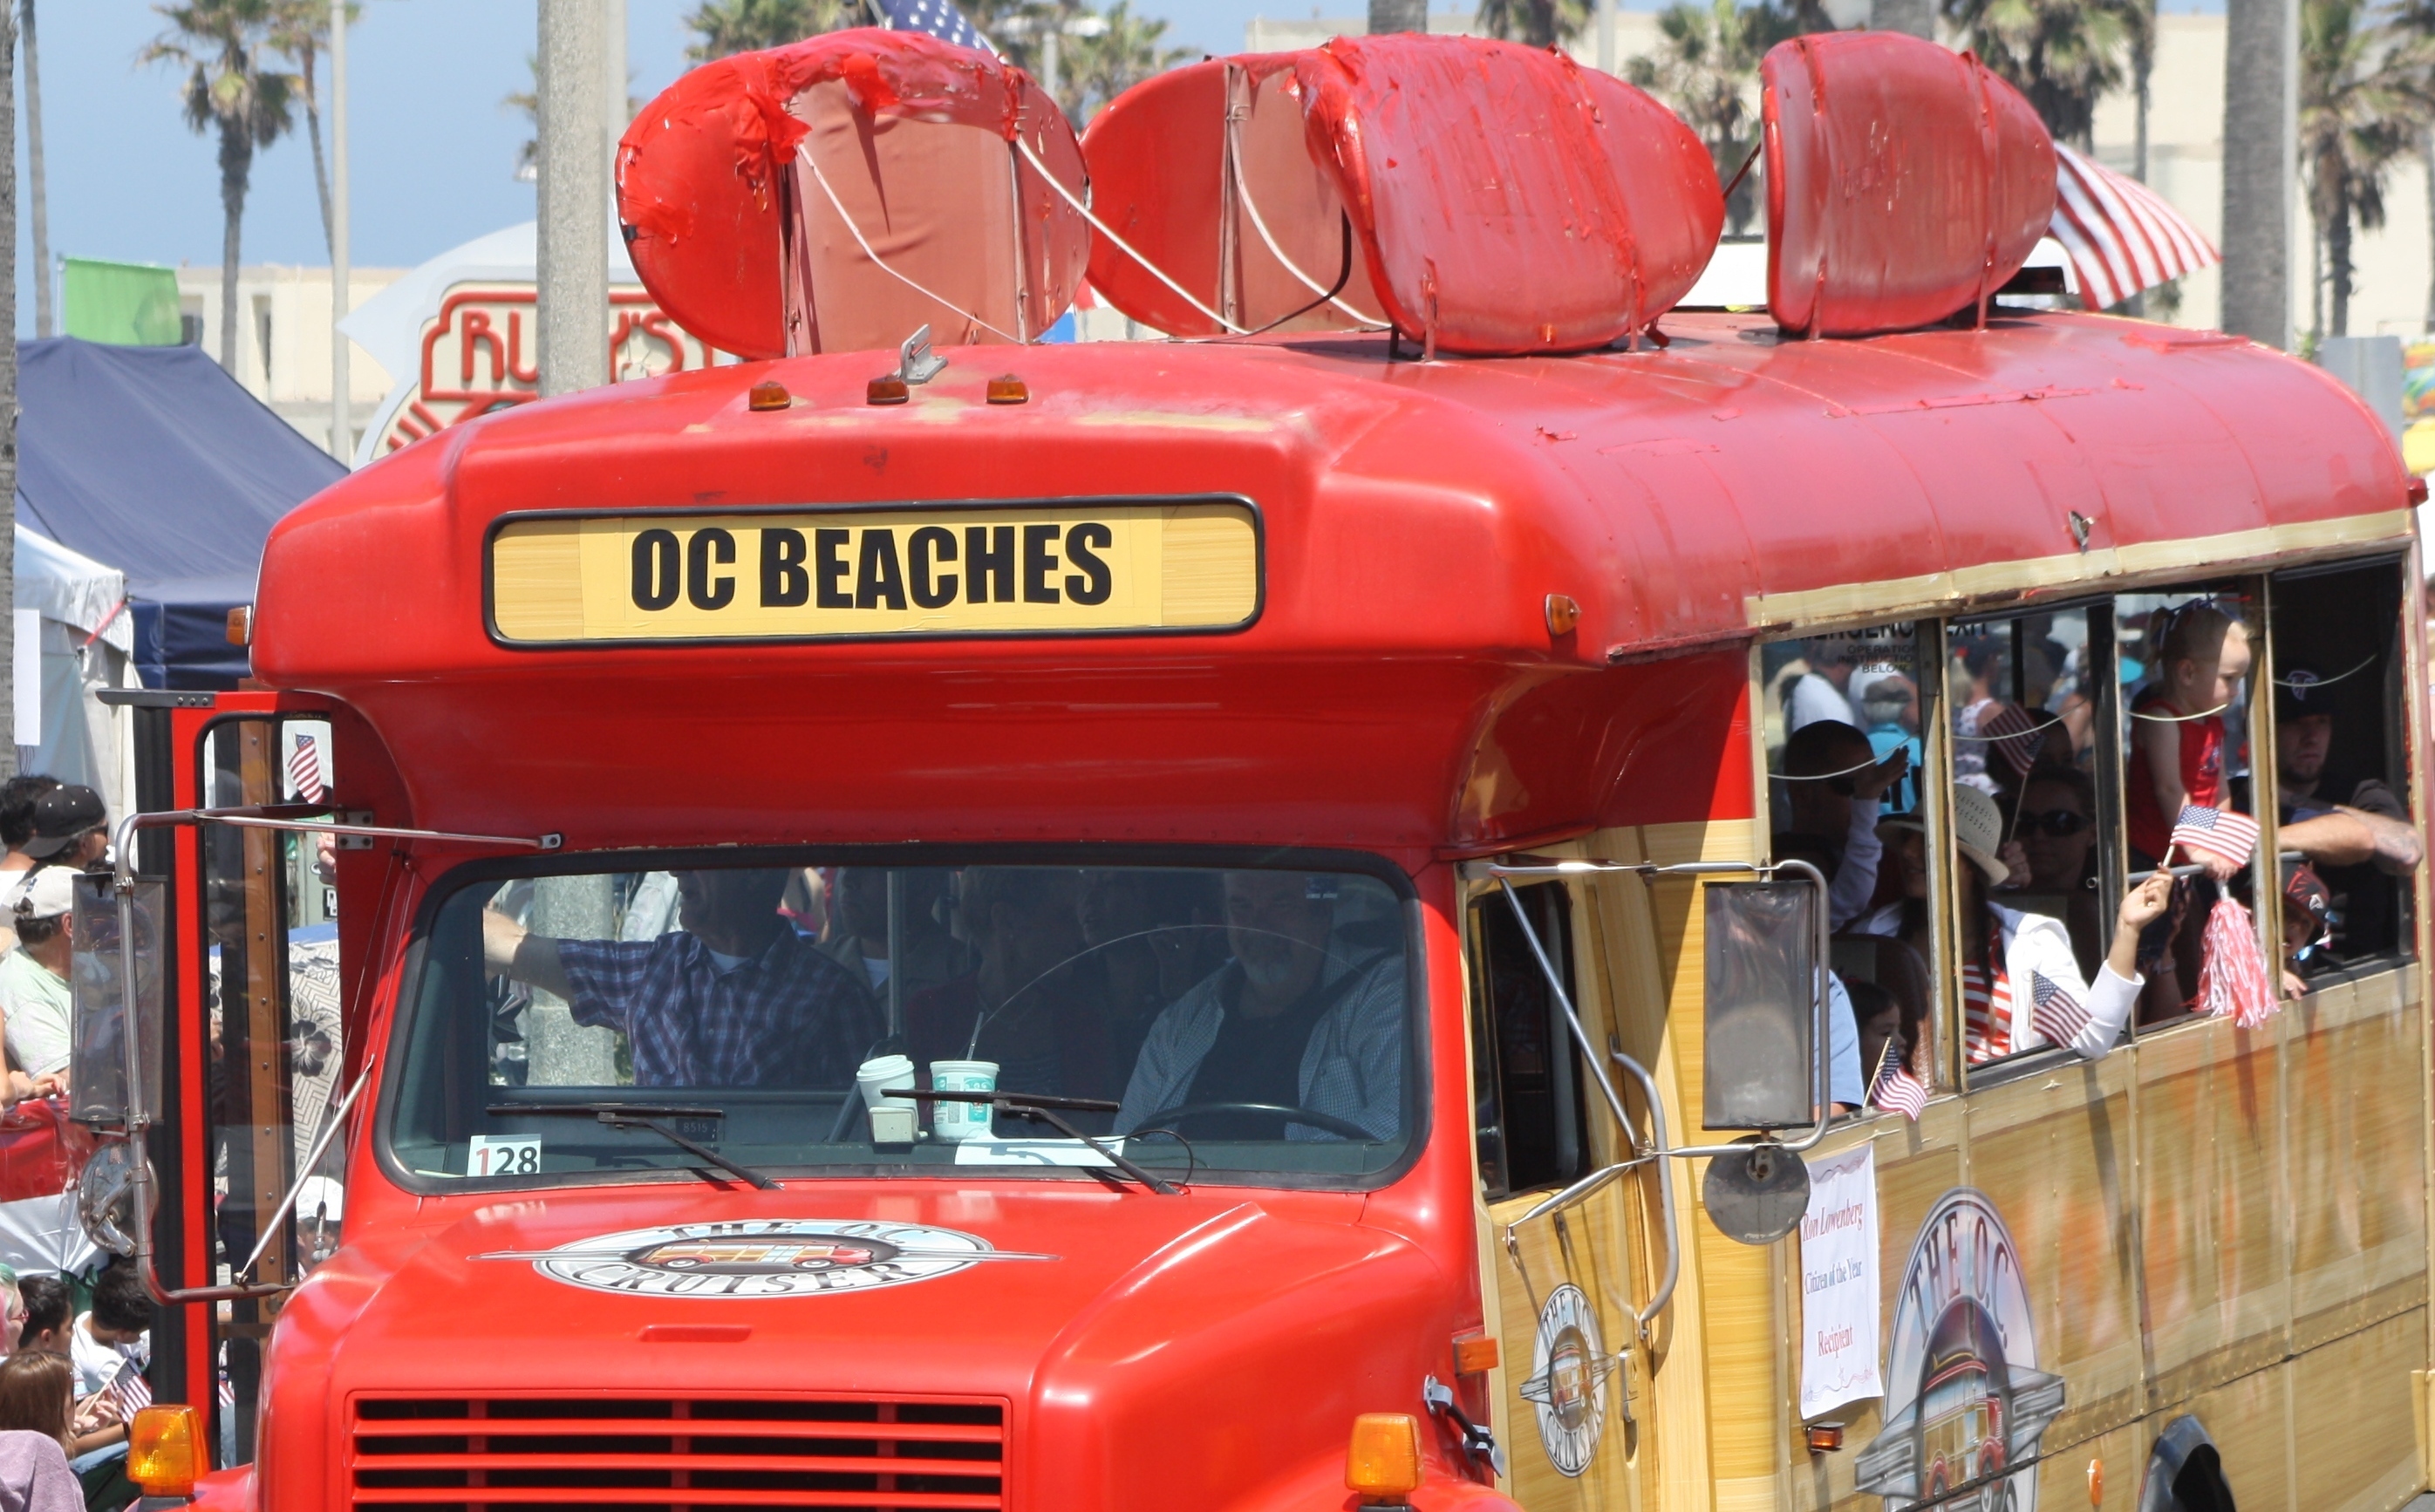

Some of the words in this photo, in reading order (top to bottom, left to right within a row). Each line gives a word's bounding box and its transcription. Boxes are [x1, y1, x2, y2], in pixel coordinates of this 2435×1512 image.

[461, 310, 684, 383] RUY'S
[630, 528, 736, 610] OC
[760, 522, 1113, 610] BEACHES
[1862, 664, 1906, 673] BELOW
[475, 1147, 538, 1175] 128
[658, 1222, 801, 1240] THE
[1802, 1213, 1818, 1242] Ron
[1819, 1198, 1863, 1231] Lowenberg
[571, 1262, 924, 1295] CRUISER
[1804, 1270, 1828, 1295] Citizen
[1829, 1263, 1836, 1286] of
[1836, 1262, 1847, 1284] the
[1846, 1257, 1862, 1280] Year
[1908, 1210, 1961, 1350] THE
[1543, 1292, 1567, 1346] THE
[1818, 1322, 1853, 1359] Recipient
[1545, 1391, 1603, 1468] CRUISER
